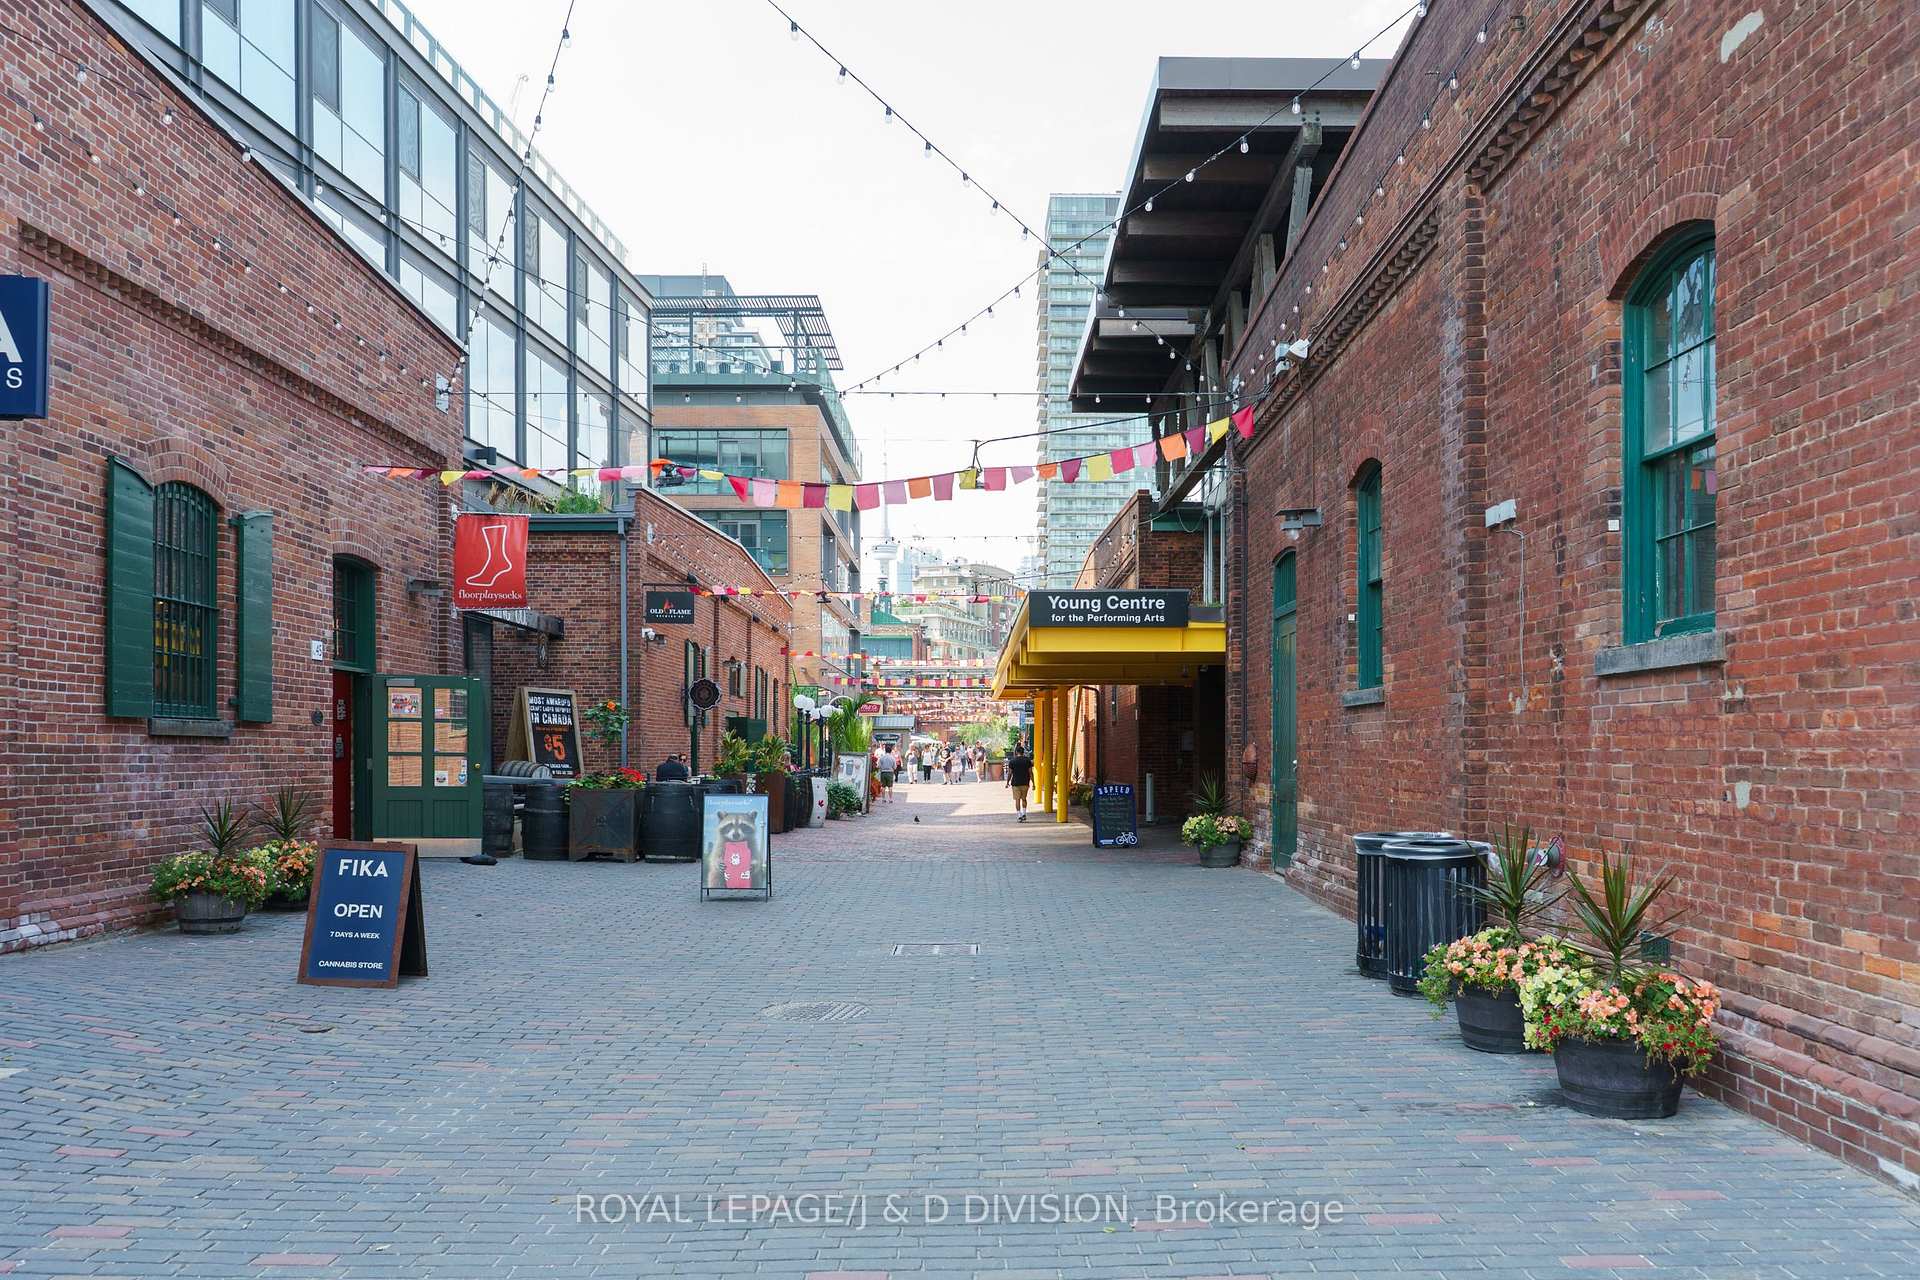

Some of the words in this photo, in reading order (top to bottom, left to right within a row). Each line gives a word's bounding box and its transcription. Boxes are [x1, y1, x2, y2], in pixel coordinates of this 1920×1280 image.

[458, 589, 522, 601] floorplaysocks
[1048, 595, 1101, 612] Young
[1106, 595, 1166, 610] Centre
[1051, 614, 1066, 622] for
[1068, 614, 1084, 622] the
[1087, 614, 1141, 624] Performing
[1144, 614, 1166, 622] Arts
[529, 696, 545, 705] MOST
[531, 712, 540, 724] IN
[542, 713, 573, 726] CANADA
[544, 733, 566, 761] $5
[338, 858, 388, 878] FIKA
[334, 903, 383, 919] OPEN
[318, 960, 357, 968] CANNABIS
